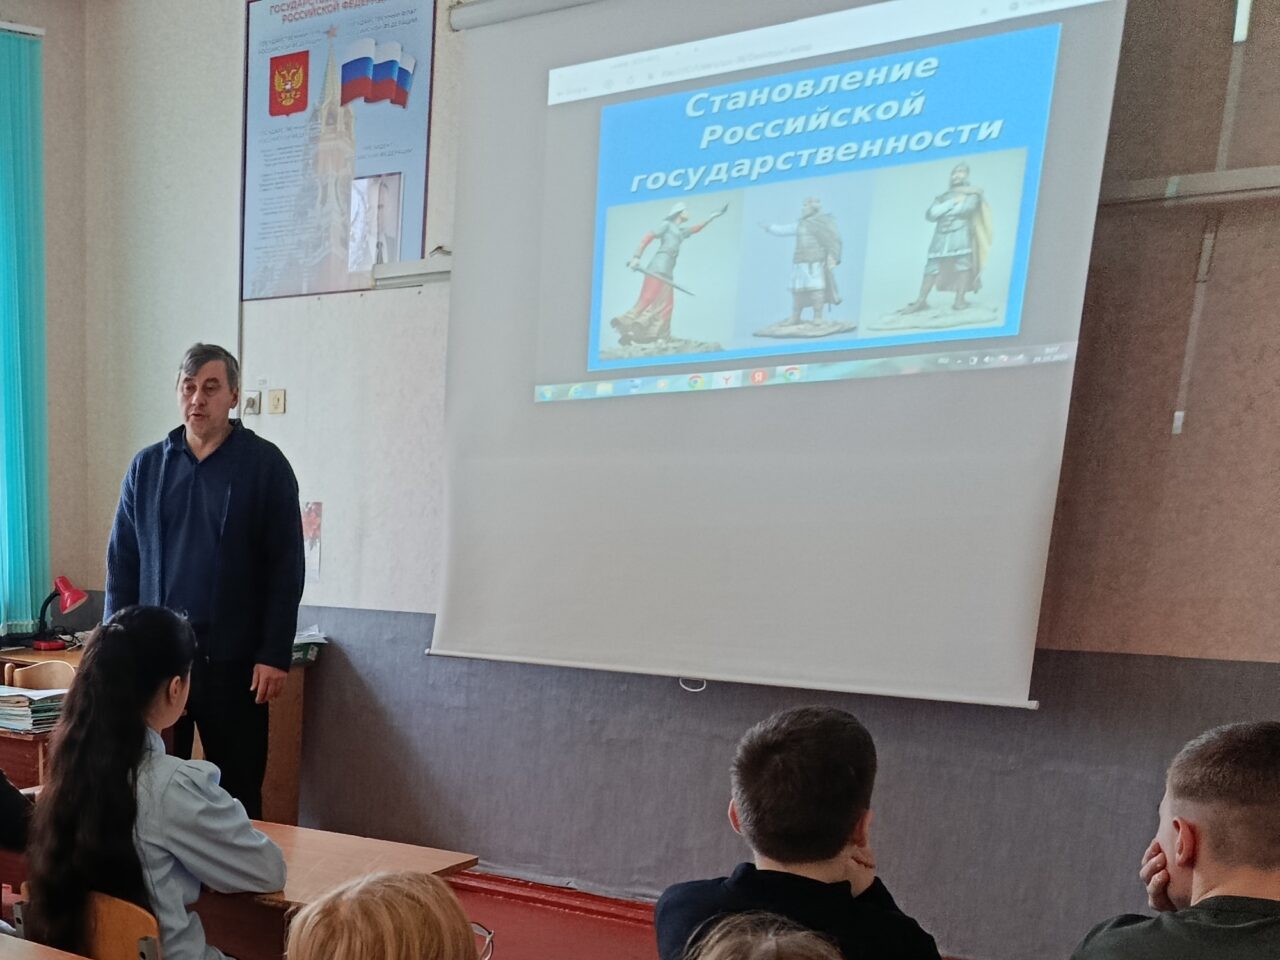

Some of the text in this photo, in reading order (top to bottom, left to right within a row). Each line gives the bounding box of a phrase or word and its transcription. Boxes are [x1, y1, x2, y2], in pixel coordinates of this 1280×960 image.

[685, 56, 940, 119] Становление
[699, 89, 926, 150] Российской
[630, 118, 1004, 193] государственности
